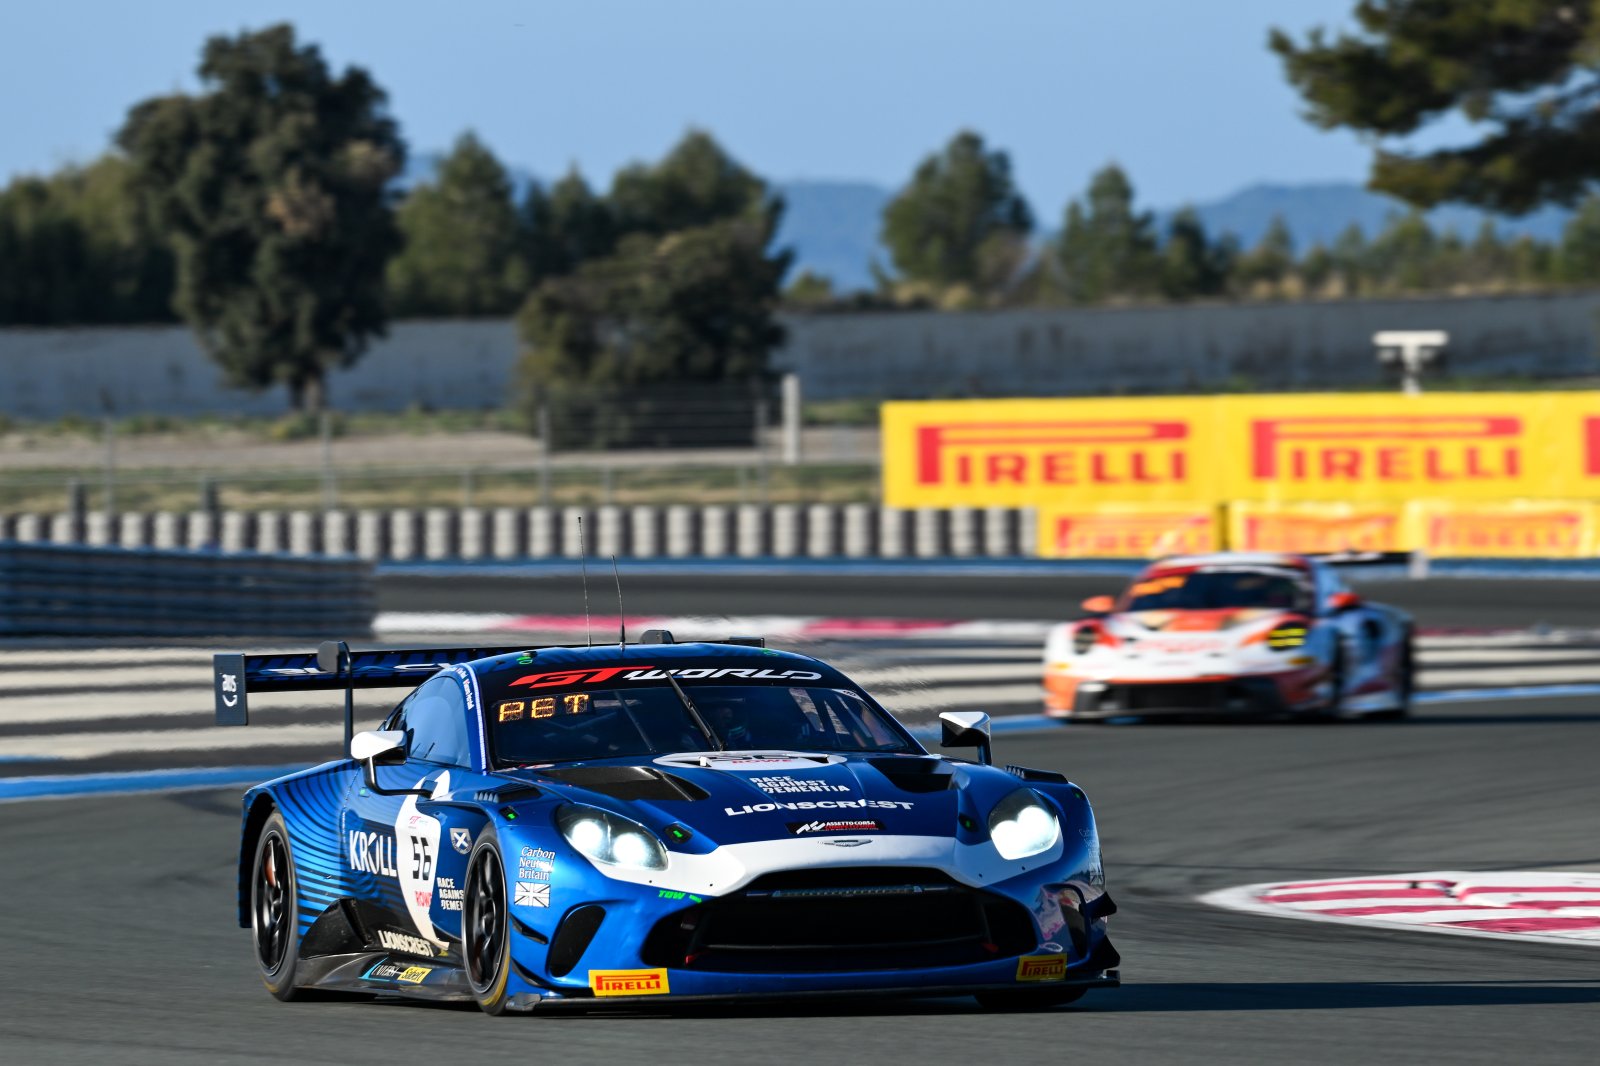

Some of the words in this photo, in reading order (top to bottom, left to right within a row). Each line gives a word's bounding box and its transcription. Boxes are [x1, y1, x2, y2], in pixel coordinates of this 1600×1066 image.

[917, 421, 1190, 485] PIRELLI
[1251, 416, 1522, 480] PIRELLI
[508, 666, 655, 688] GT
[622, 668, 822, 681] WORLD
[750, 776, 795, 784] RACE
[757, 780, 828, 789] AGAINST
[763, 785, 850, 794] DEMENTIA
[724, 799, 914, 815] LIONSCREST
[411, 835, 431, 881] 56
[521, 846, 556, 860] Carbon
[519, 856, 554, 870] Neutl
[519, 867, 550, 881] Britain
[437, 877, 455, 888] RACE
[439, 888, 464, 900] AGAINS
[658, 889, 686, 900] TOW
[377, 929, 435, 957] LIONSCREST
[1021, 958, 1064, 977] PIRELLI
[595, 973, 661, 991] PIRELLI
